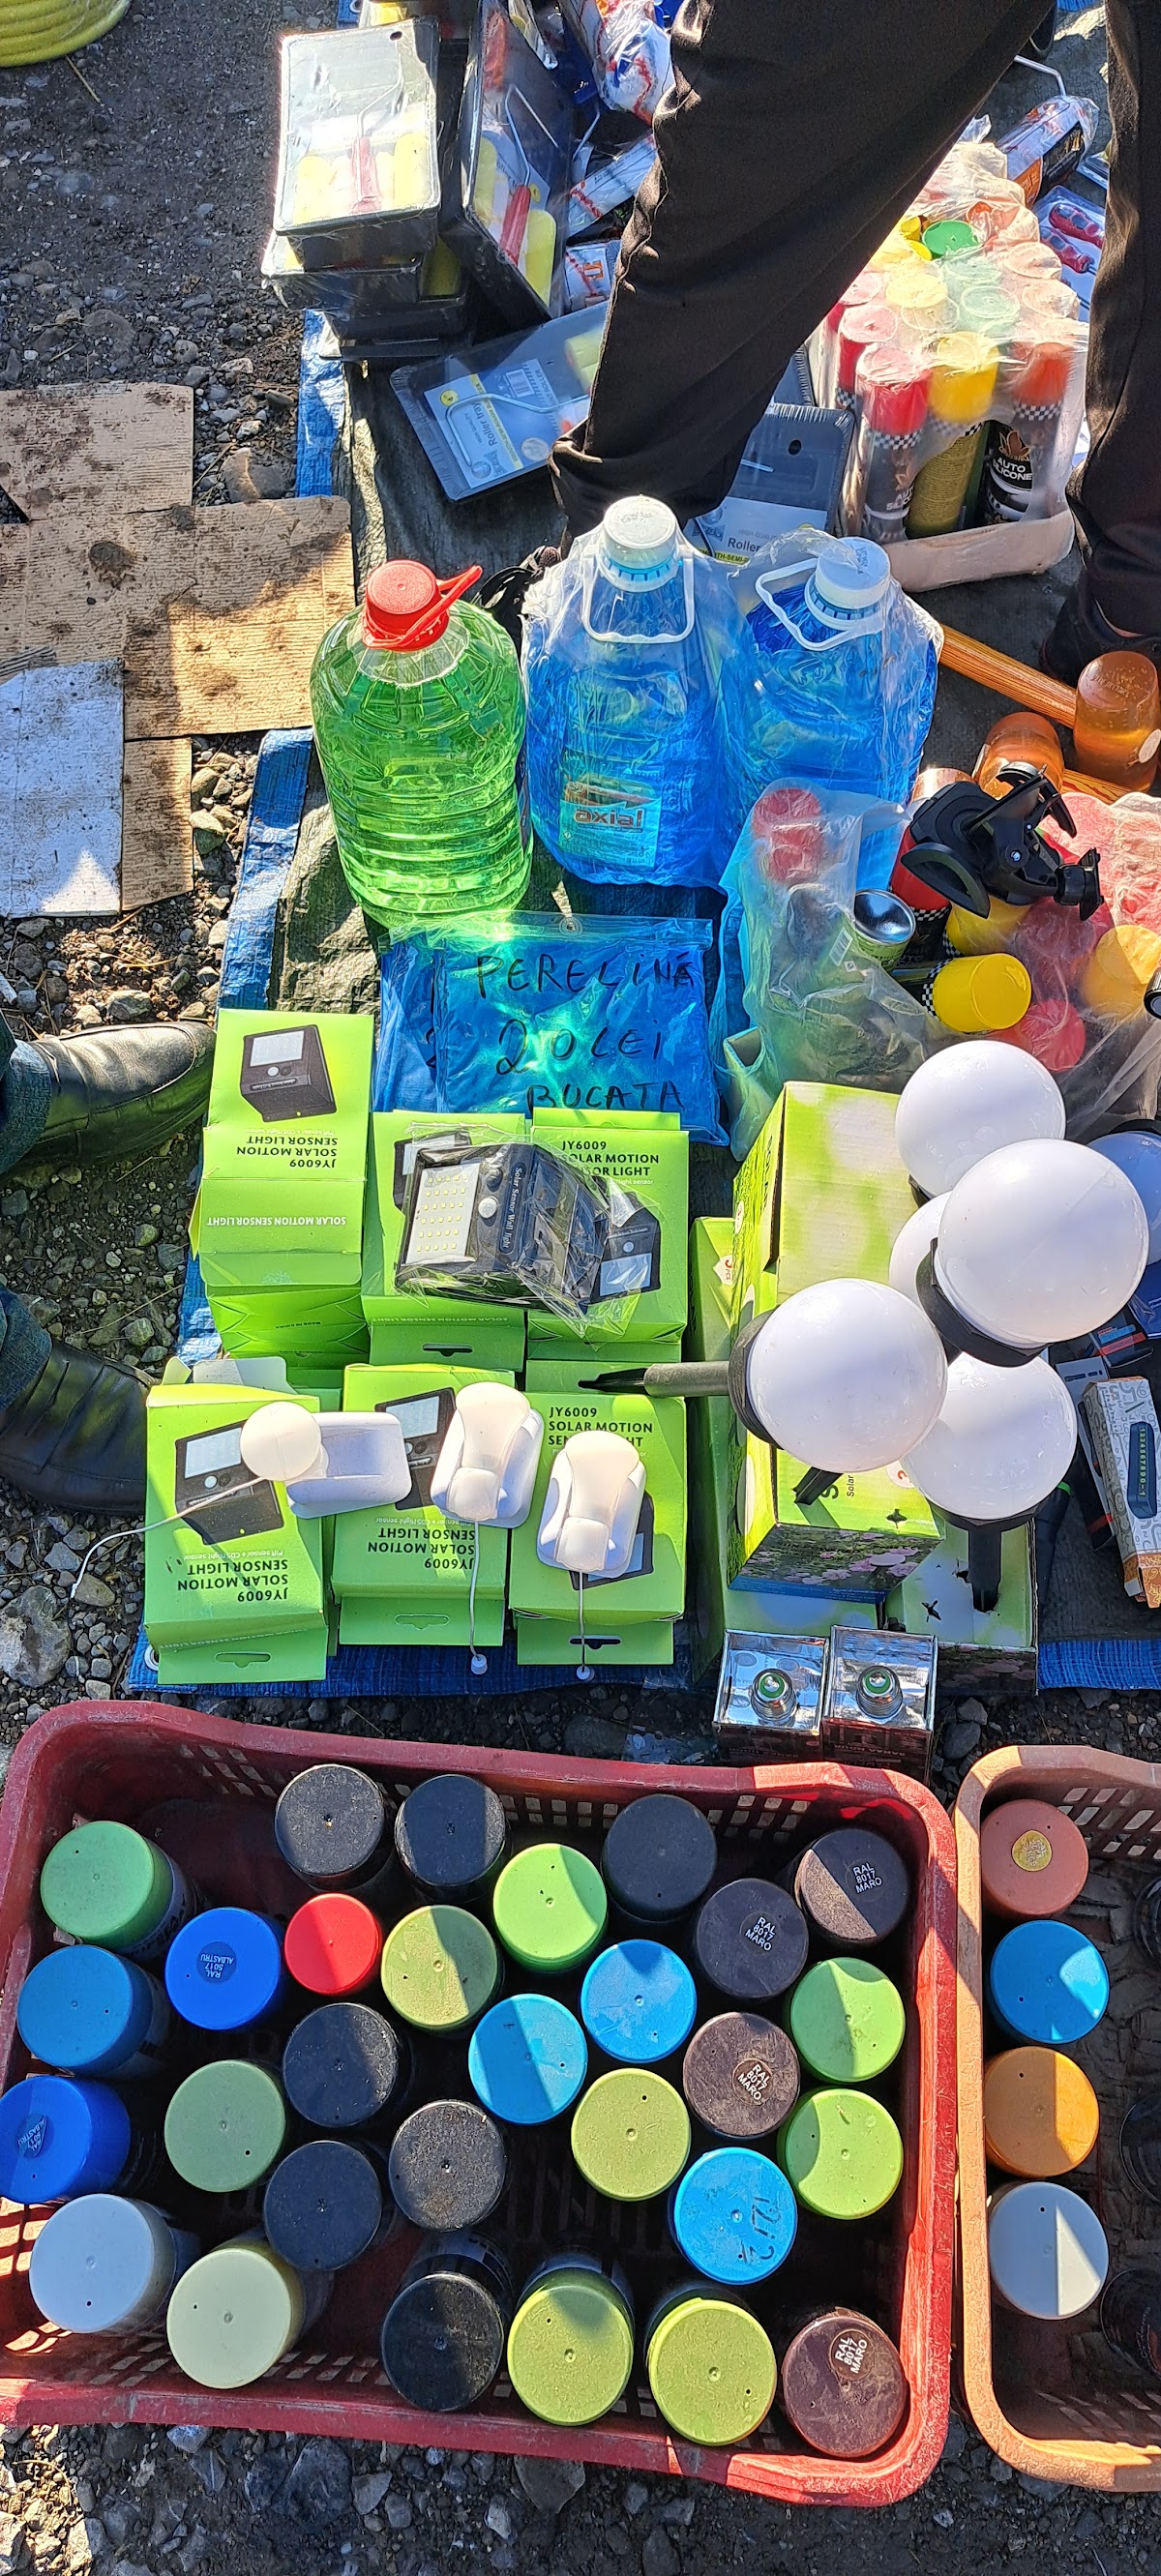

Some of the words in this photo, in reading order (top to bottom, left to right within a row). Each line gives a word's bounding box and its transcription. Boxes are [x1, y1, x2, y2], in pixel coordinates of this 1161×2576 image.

[472, 401, 486, 420] tray
[480, 418, 497, 447] Roller
[997, 457, 1027, 473] AUTO
[728, 537, 760, 552] Roller
[574, 808, 644, 827] axial
[527, 1080, 685, 1112] BUCATA
[246, 1136, 284, 1144] LIGHT
[288, 1137, 339, 1145] SENSOR
[561, 1140, 607, 1151] JY6009
[236, 1146, 291, 1156] MOTION
[295, 1148, 338, 1157] SOLAR
[289, 1159, 337, 1168] JY6009
[606, 1154, 659, 1164] MOTION
[514, 1167, 523, 1187] Solar
[613, 1167, 650, 1176] LIGHT
[510, 1187, 521, 1210] Sensor
[207, 1217, 234, 1226] LIGHT
[507, 1210, 518, 1229] Wall
[549, 1407, 597, 1418] JY6009
[548, 1421, 592, 1431] SOLAR
[596, 1422, 653, 1433] MOTION
[846, 1474, 855, 1497] Solar
[378, 1527, 419, 1539] LIGHT
[423, 1528, 475, 1540] SENSOR
[368, 1541, 428, 1554] MOTION
[430, 1544, 475, 1554] SOLAR
[187, 1562, 229, 1575] LIGHT
[232, 1559, 288, 1573] SENSOR
[424, 1557, 475, 1569] JY6009
[177, 1577, 238, 1591] MOTION
[240, 1574, 288, 1587] SOLAR
[237, 1588, 288, 1602] JY6009
[852, 1862, 875, 1877] RAL
[855, 1870, 876, 1884] 8017
[855, 1878, 882, 1893] MARO
[753, 1924, 774, 1940] 8017
[758, 1916, 776, 1935] RAL
[745, 1929, 772, 1951] MARO
[200, 1954, 234, 1965] ALBASTRU
[205, 1962, 223, 1970] 5017
[206, 1969, 222, 1978] RAL
[746, 2071, 767, 2091] 8017
[752, 2063, 770, 2087] RAL
[737, 2073, 762, 2100] MARO
[835, 2337, 850, 2361] RAL
[844, 2337, 858, 2366] 8017
[849, 2339, 868, 2374] MARO
